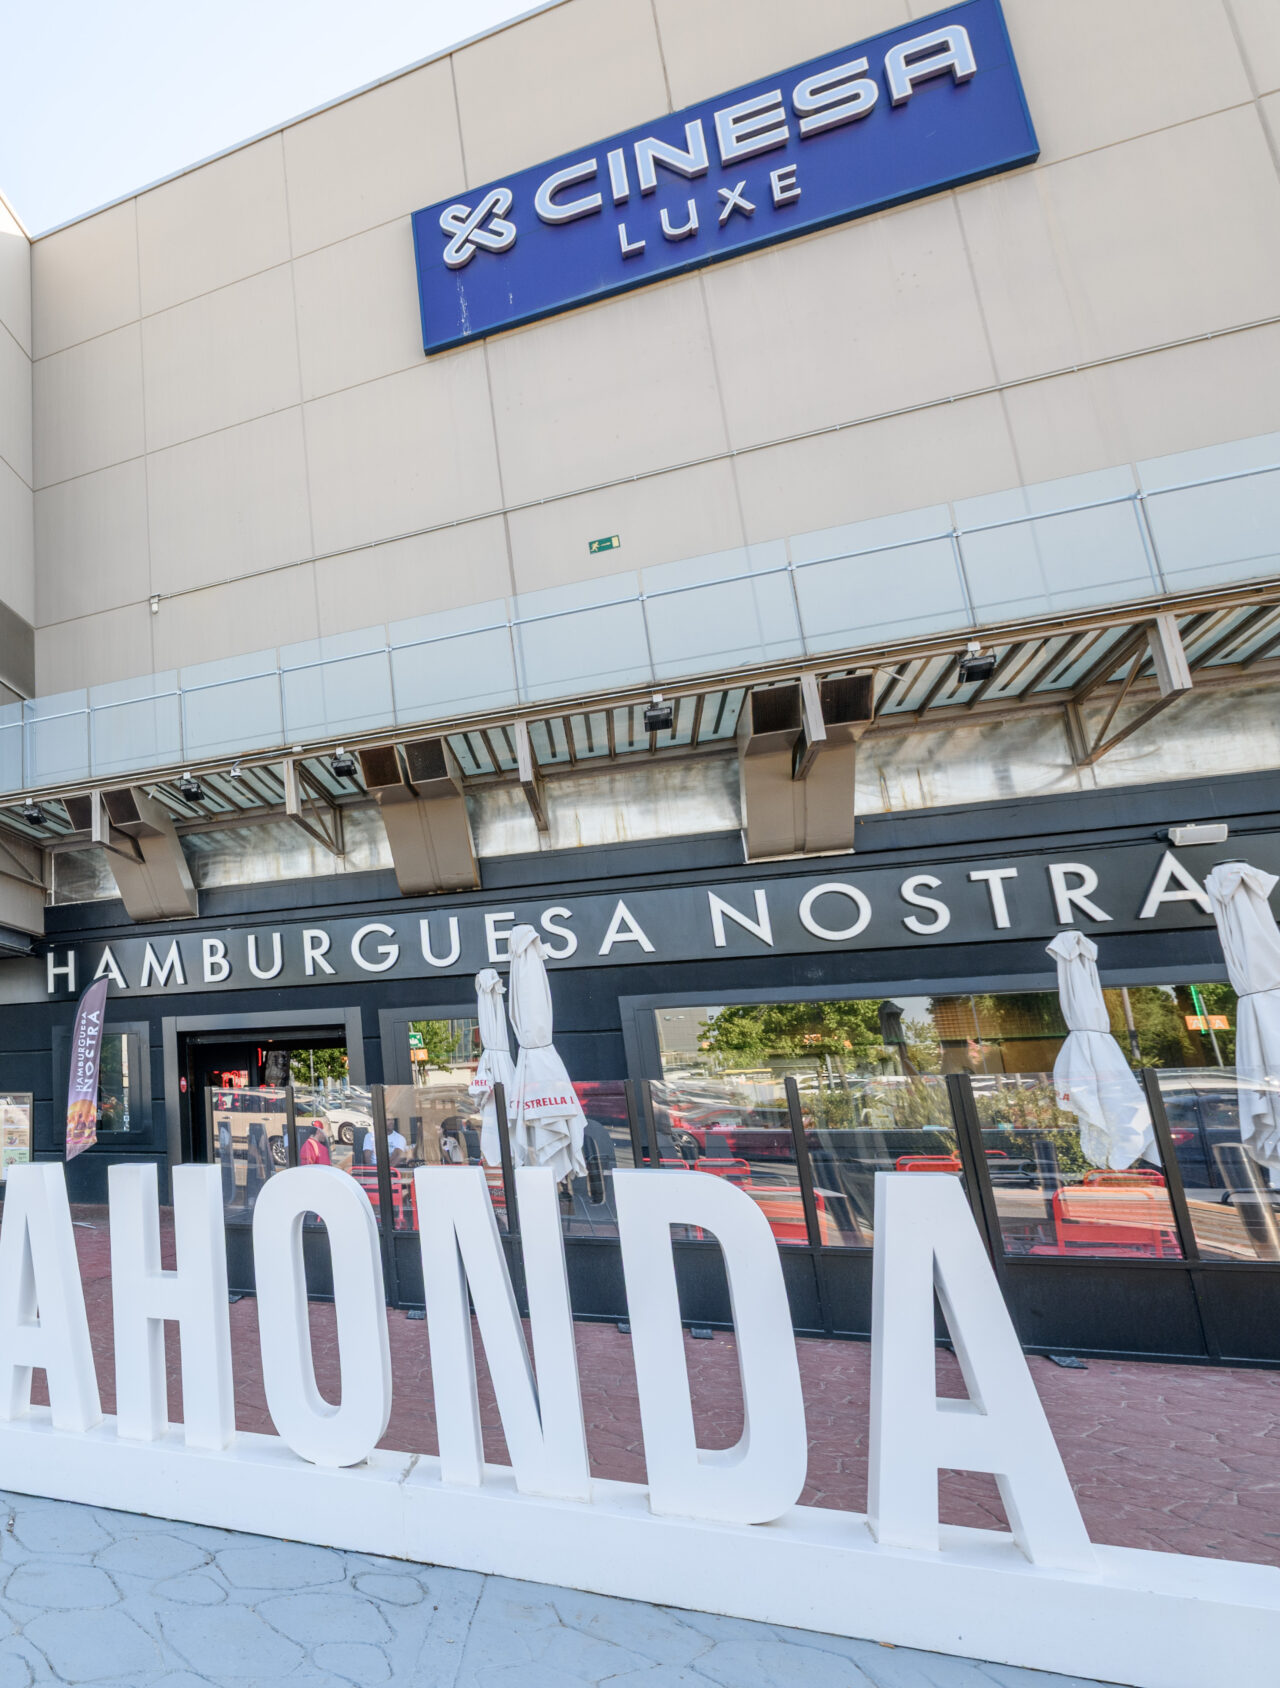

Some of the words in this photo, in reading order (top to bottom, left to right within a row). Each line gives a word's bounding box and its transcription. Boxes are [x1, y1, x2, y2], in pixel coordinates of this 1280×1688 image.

[534, 24, 977, 225] CINESA
[618, 164, 802, 257] LUXE
[47, 899, 656, 993] HAMBURGUESA
[707, 849, 1215, 947] NOSTRA
